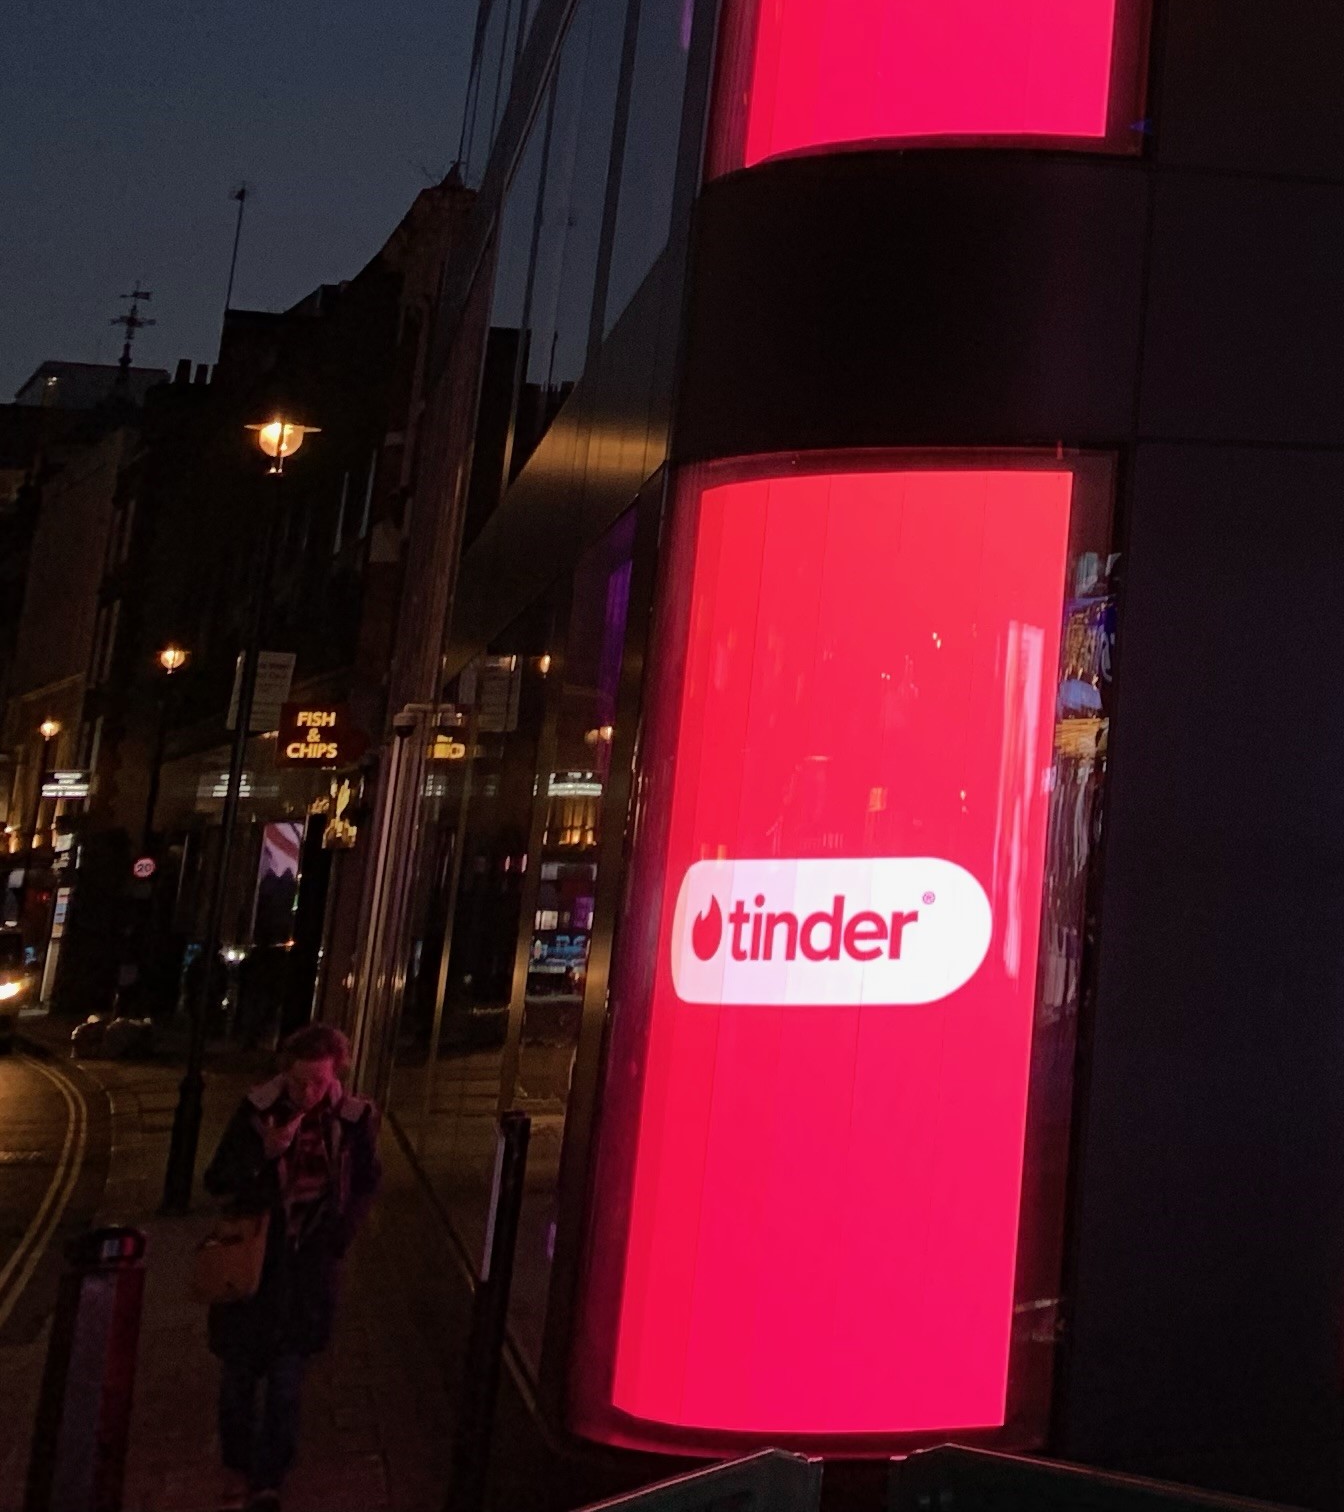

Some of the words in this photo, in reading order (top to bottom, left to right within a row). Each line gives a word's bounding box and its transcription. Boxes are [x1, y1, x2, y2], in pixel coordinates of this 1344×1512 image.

[296, 711, 337, 727] FISH
[306, 727, 321, 743] &
[286, 742, 338, 759] CHIPS
